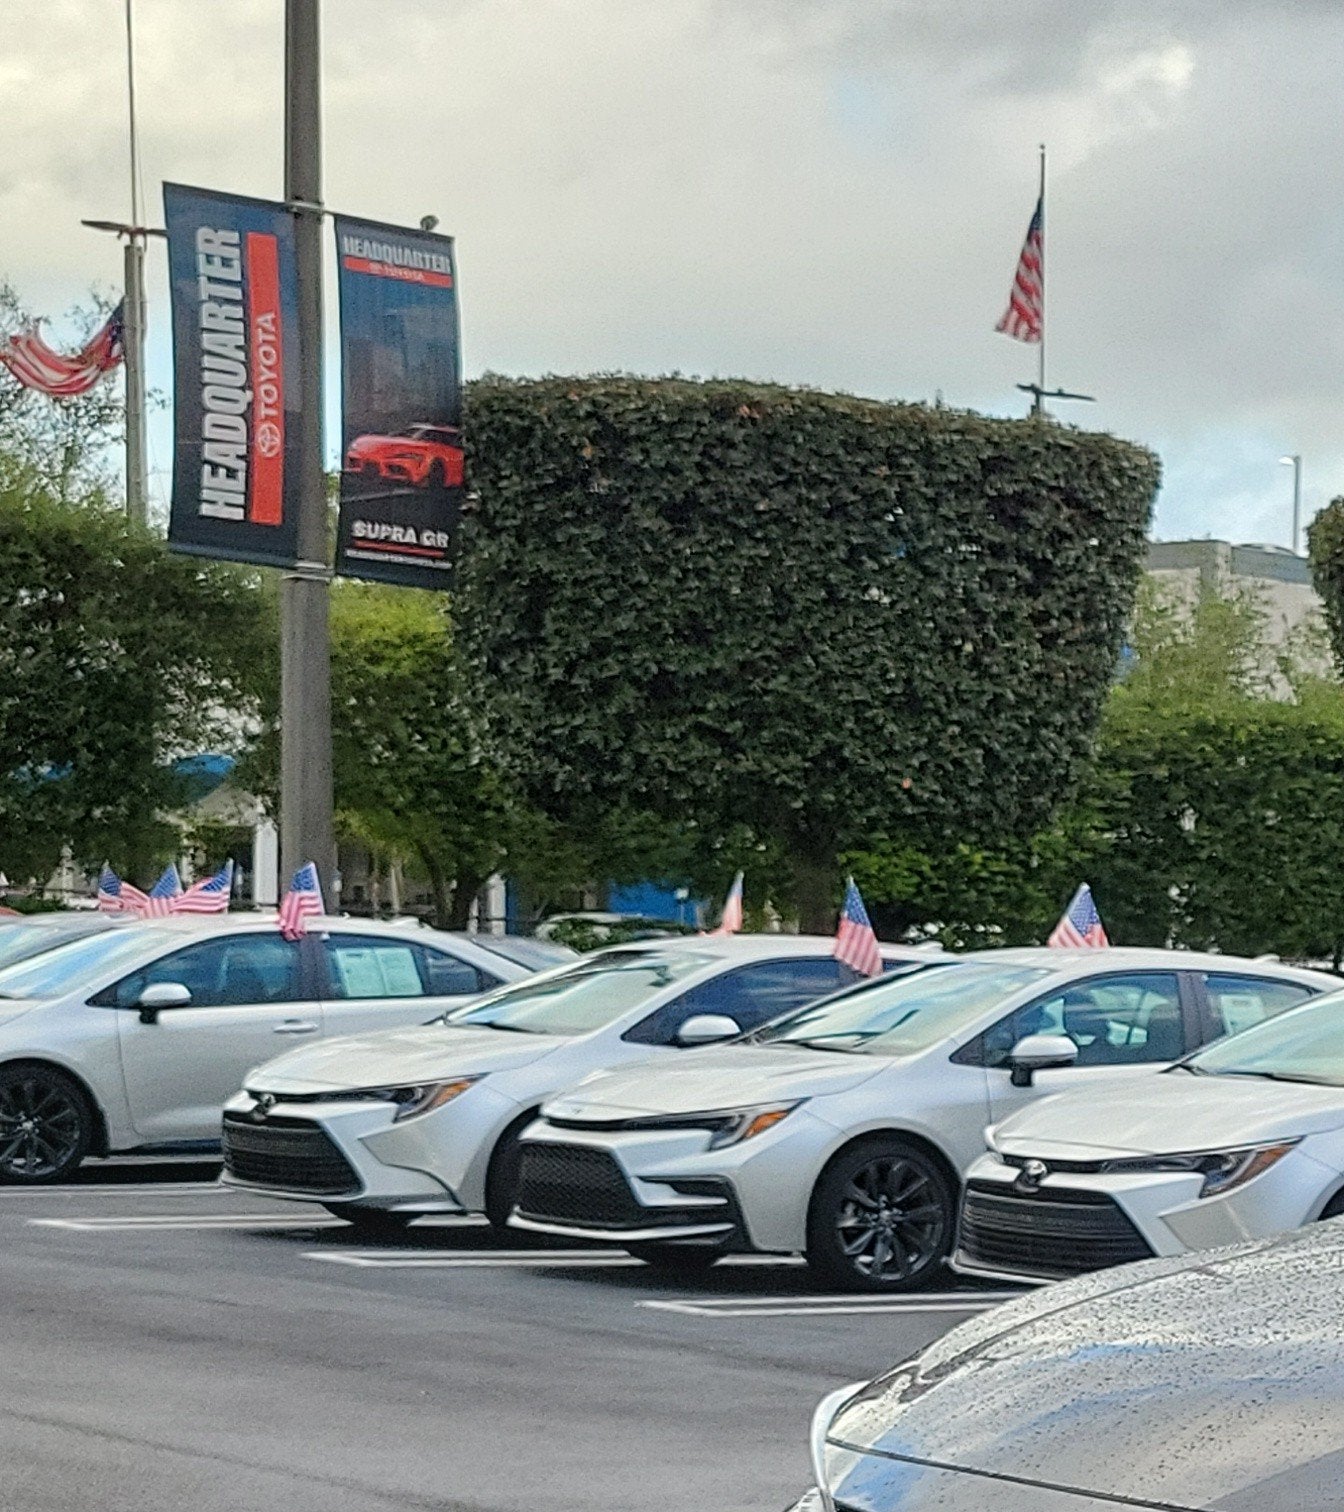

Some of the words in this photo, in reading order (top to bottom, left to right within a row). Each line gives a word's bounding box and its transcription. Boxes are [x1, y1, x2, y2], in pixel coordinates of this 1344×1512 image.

[343, 236, 451, 273] HEADQUARTER
[196, 226, 252, 521] HEADQUARTER
[257, 311, 280, 419] TOYOTA
[352, 520, 418, 544] SUPRA
[420, 530, 449, 548] GR
